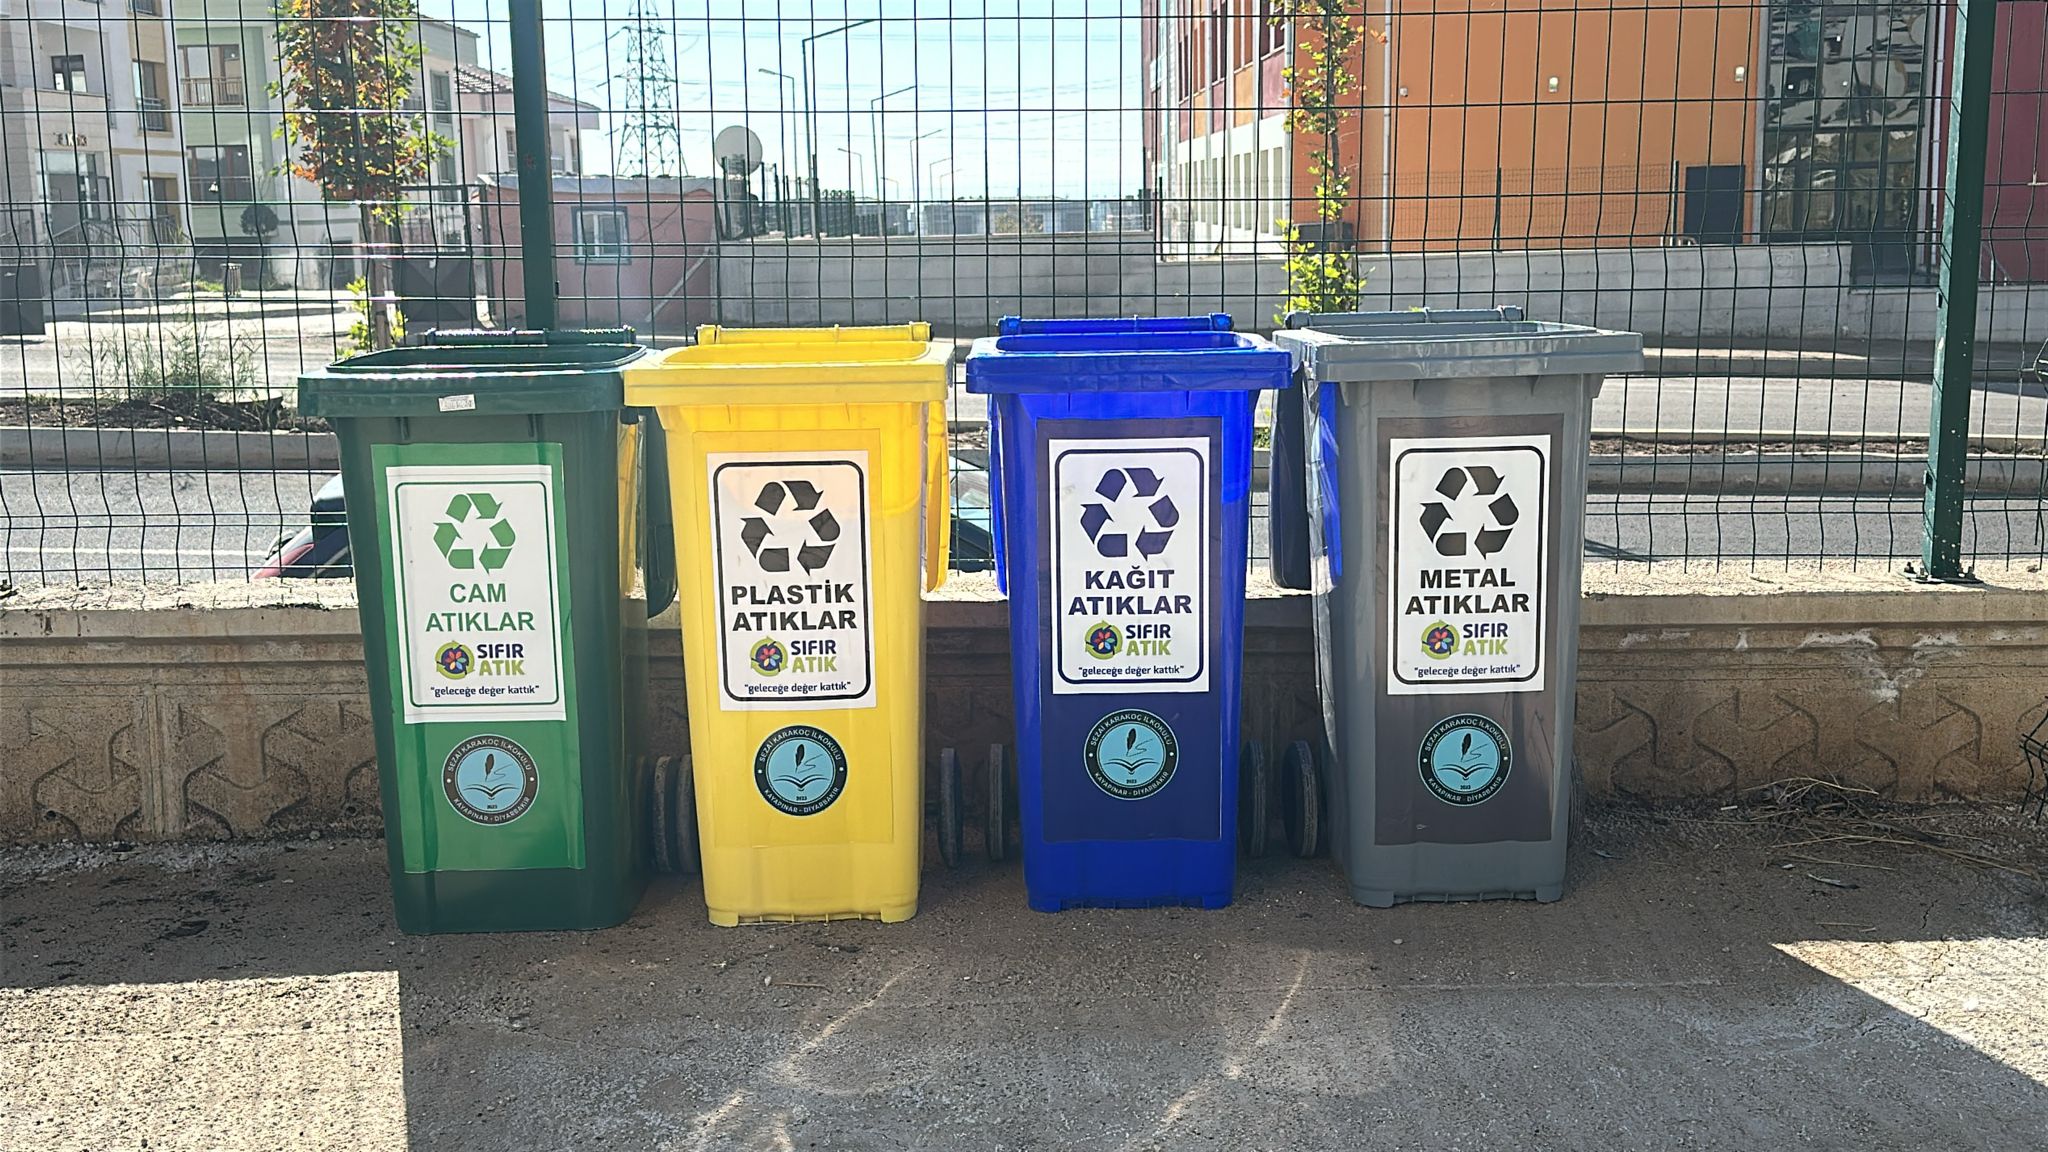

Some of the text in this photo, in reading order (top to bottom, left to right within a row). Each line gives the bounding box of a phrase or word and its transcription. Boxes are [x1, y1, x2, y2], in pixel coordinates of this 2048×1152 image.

[1085, 565, 1175, 590] KAĞIT
[1420, 567, 1516, 589] METAL
[449, 582, 507, 603] CAM
[731, 579, 856, 605] PLASTİK
[1067, 595, 1193, 616] ATIKLAR
[1404, 593, 1530, 615] ATIKLAR
[425, 611, 536, 632] ATIKLAR
[732, 610, 858, 631] ATIKLAR
[1125, 624, 1172, 639] SIFIR
[1462, 622, 1509, 639] SIFIR
[476, 643, 525, 659] SIFIR
[790, 639, 837, 656] SIFIR
[1126, 639, 1172, 656] ATIK
[1463, 639, 1509, 656] ATIK
[479, 660, 526, 676] ATIK
[791, 656, 838, 673] ATIK
[1124, 665, 1152, 677] değer
[1461, 665, 1488, 677] değer
[478, 685, 506, 697] değer
[790, 683, 818, 694] değer
[1105, 713, 1143, 729] KARAKOÇ
[1440, 718, 1478, 733] KARAKOÇ
[774, 728, 811, 744] KARAKOÇ
[462, 738, 500, 754] KARAKOÇ
[1094, 772, 1128, 796] KAYAPINAR
[1427, 777, 1462, 802] KAYAPINAR
[453, 797, 488, 821] KAYAPINAR
[764, 788, 799, 813] KAYAPINAR
